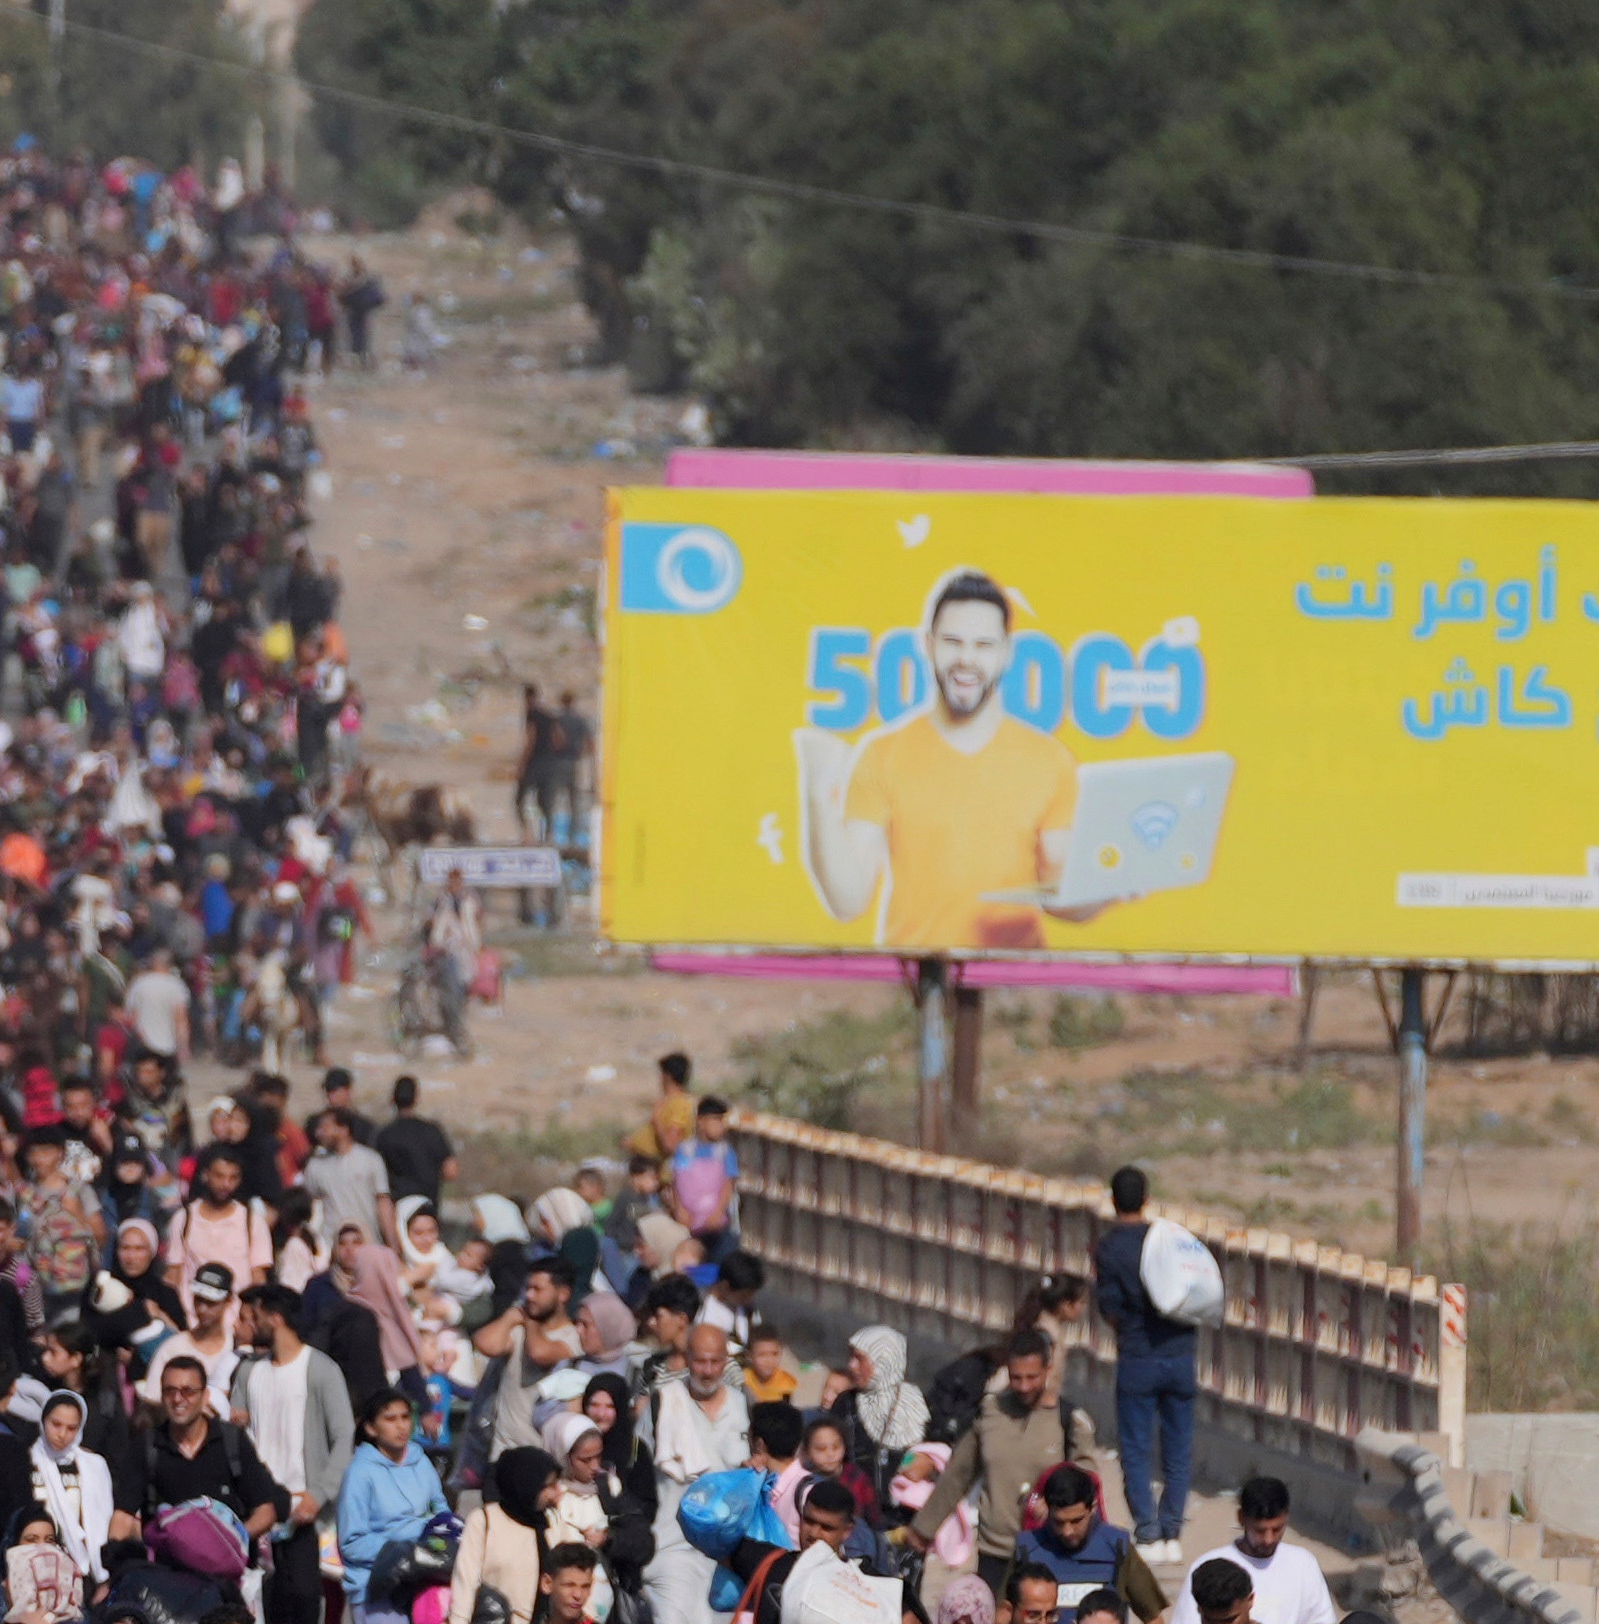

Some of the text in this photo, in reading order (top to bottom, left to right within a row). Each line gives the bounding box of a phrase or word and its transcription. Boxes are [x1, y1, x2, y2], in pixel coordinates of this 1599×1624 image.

[1294, 561, 1395, 621] نت
[1411, 543, 1559, 640] أوفر
[1401, 657, 1574, 742] كاش
